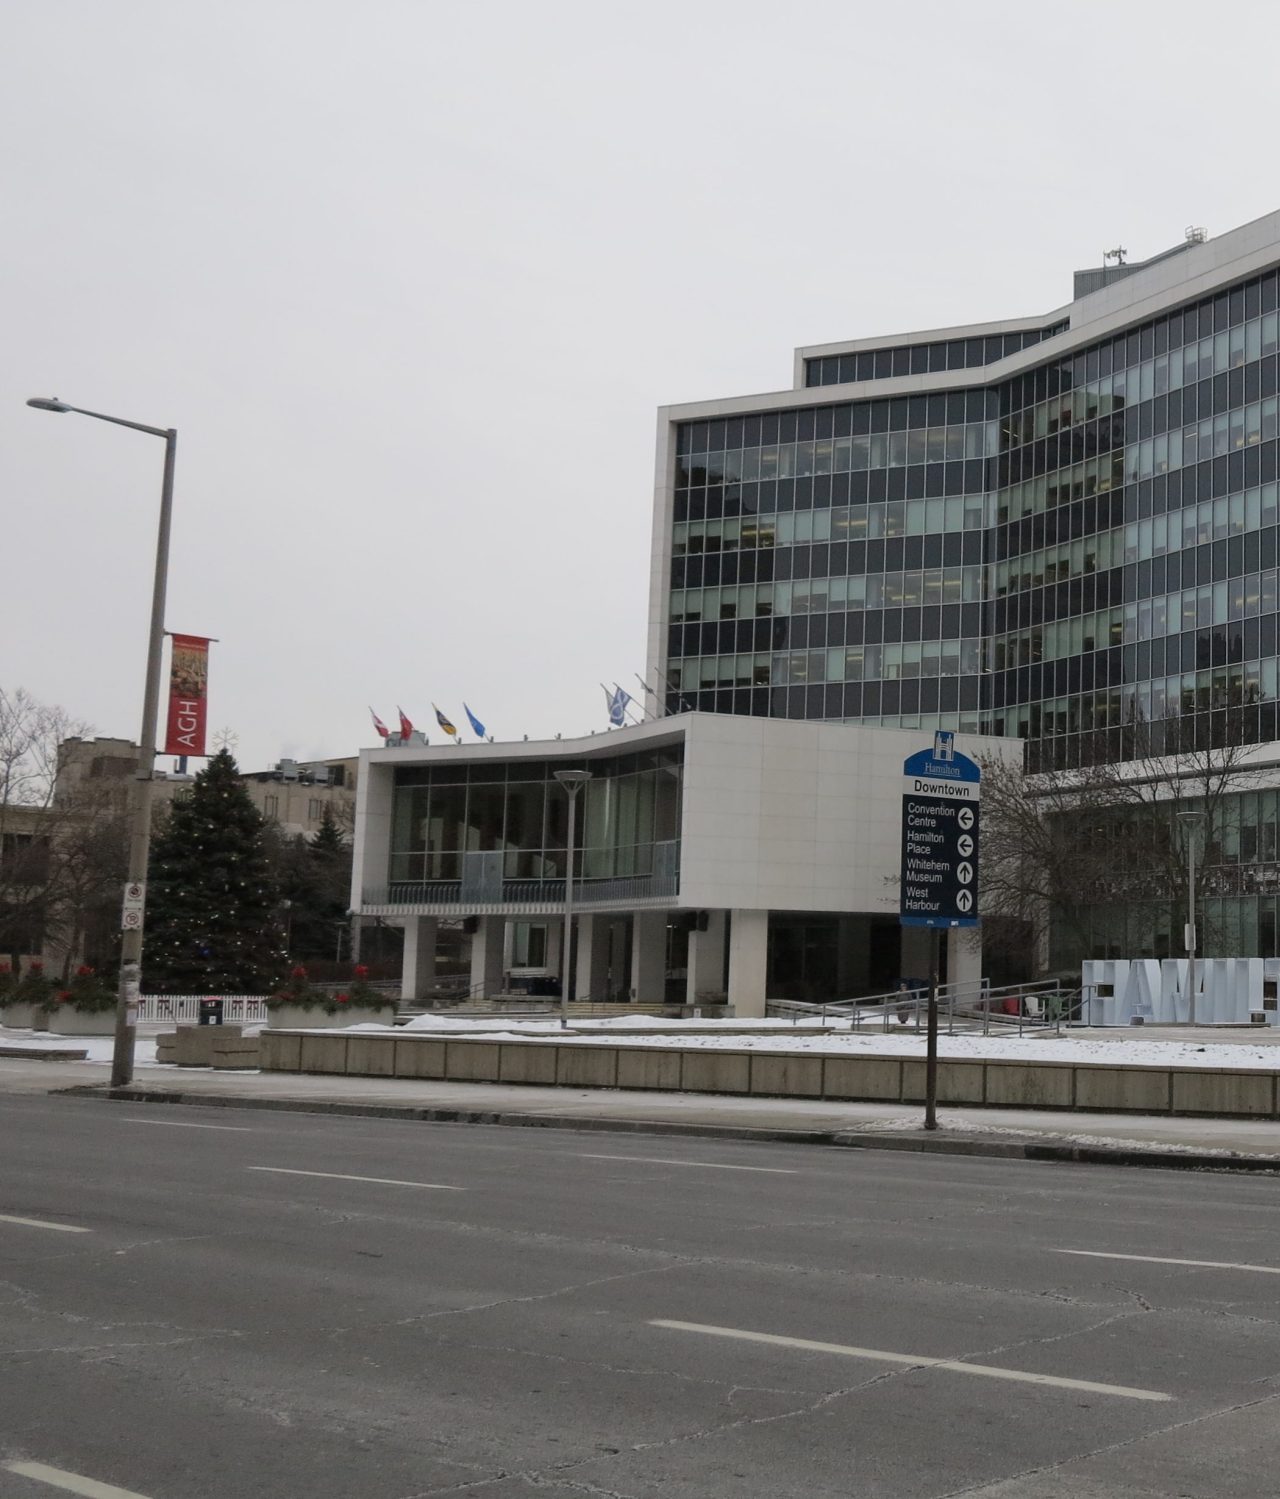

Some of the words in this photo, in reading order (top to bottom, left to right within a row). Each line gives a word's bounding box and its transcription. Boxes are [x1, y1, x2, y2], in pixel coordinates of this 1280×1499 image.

[177, 701, 198, 748] AGH
[924, 762, 960, 777] Hamilton
[914, 779, 970, 797] Downtown
[907, 802, 955, 817] Convention
[907, 815, 937, 828] Centre
[907, 830, 945, 843] Hamilton
[907, 843, 931, 855] Place
[906, 870, 943, 883] Museum
[906, 886, 929, 899] West
[905, 898, 940, 911] Harbour
